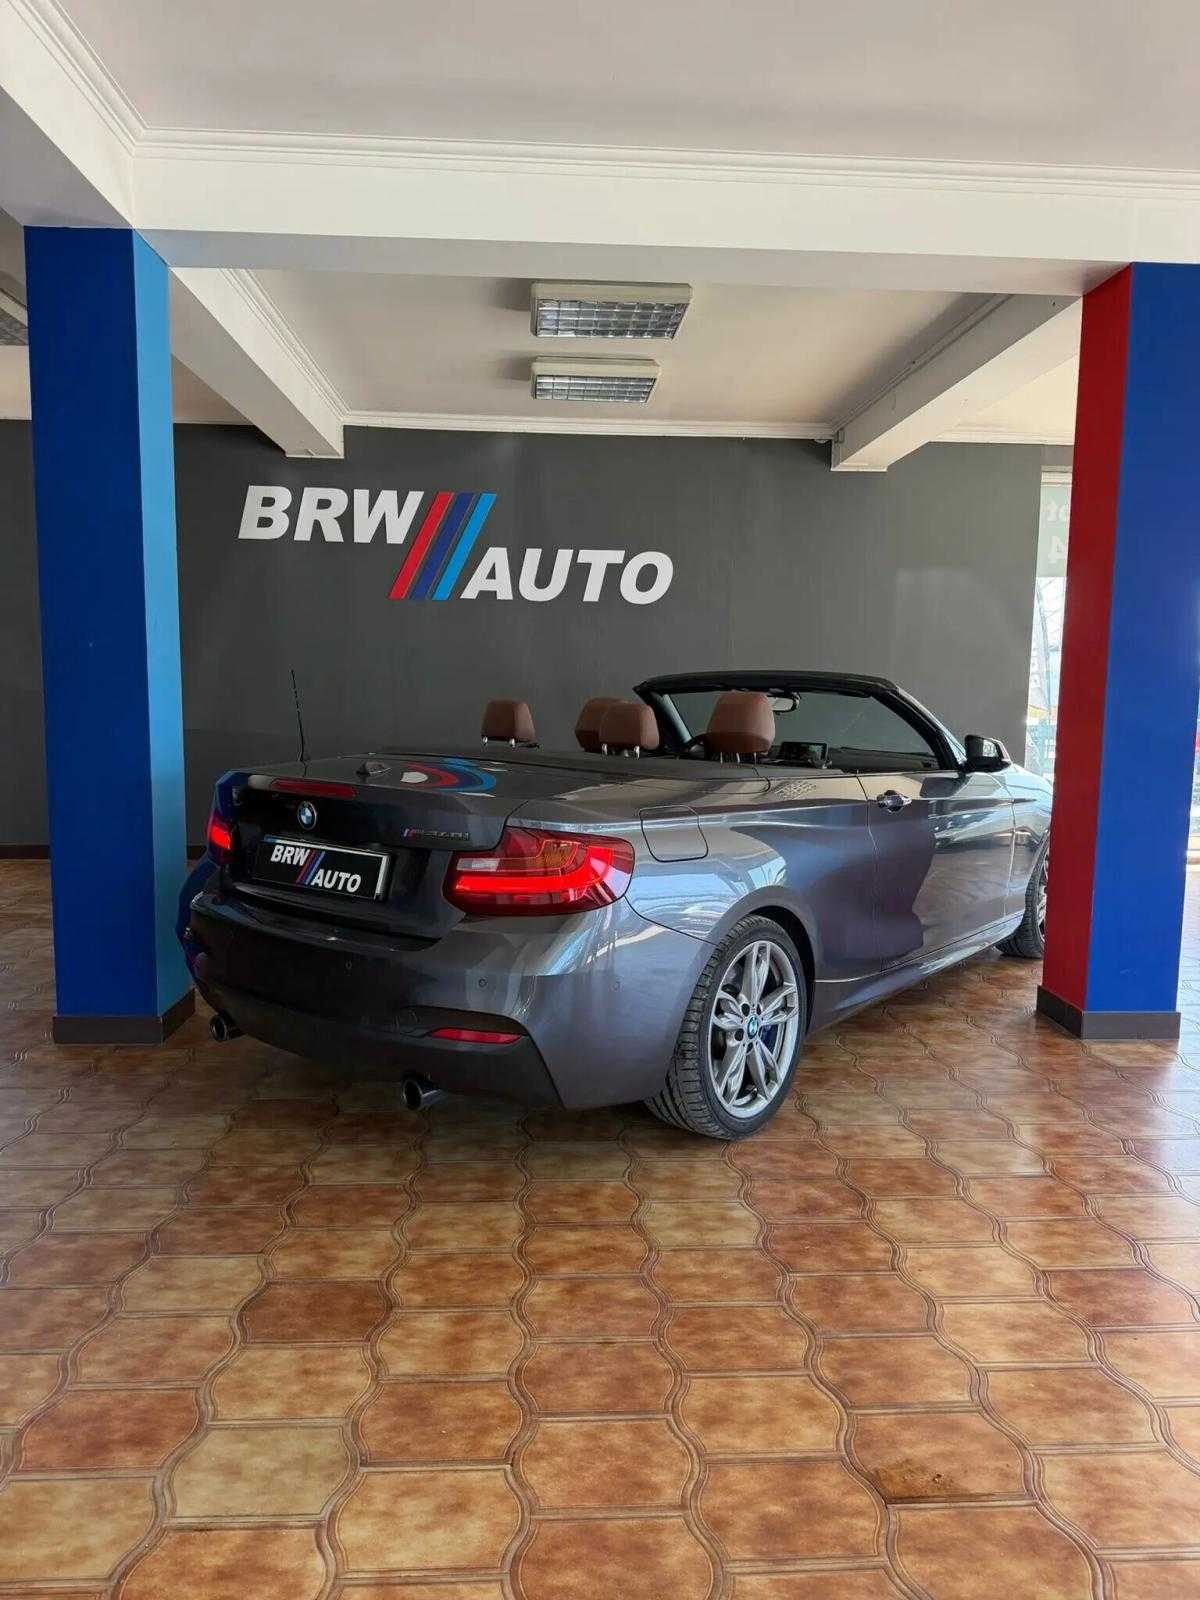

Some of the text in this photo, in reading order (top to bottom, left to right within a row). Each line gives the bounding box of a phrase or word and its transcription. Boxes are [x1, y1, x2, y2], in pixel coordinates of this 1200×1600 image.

[238, 484, 424, 544] BRW
[459, 547, 674, 605] AUTO
[270, 844, 311, 866] BRW
[310, 868, 362, 893] AUTO
